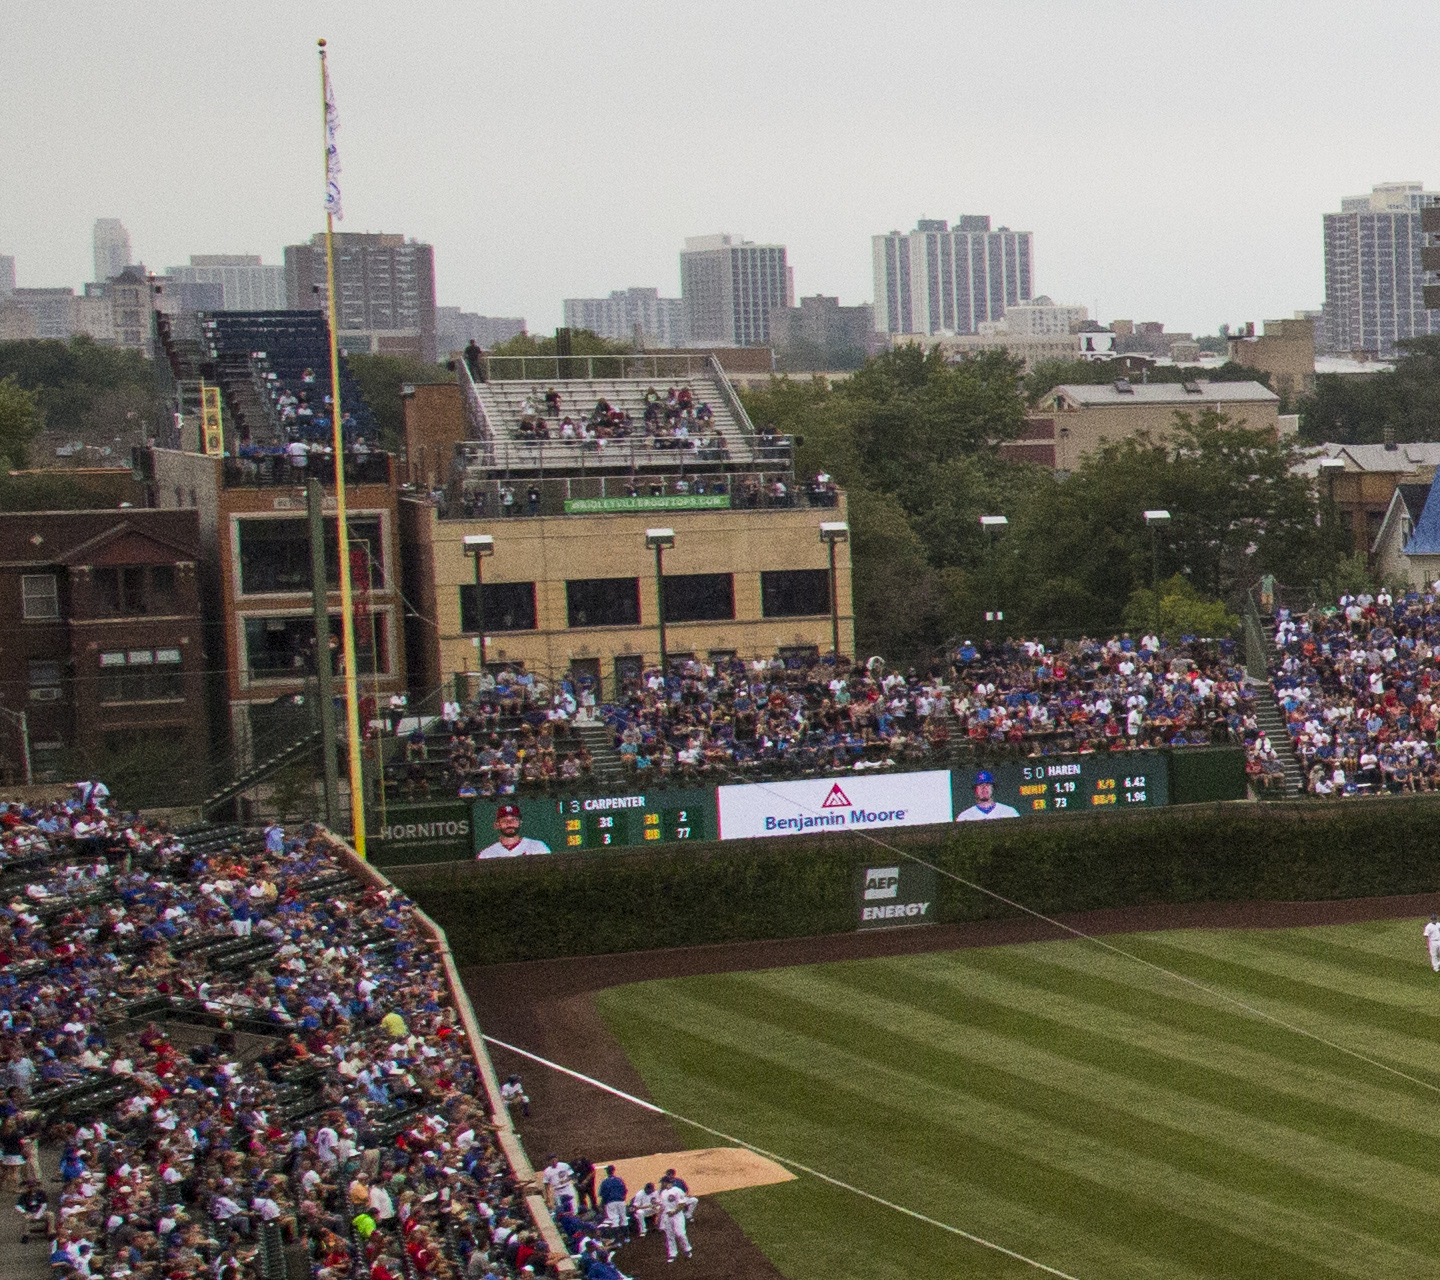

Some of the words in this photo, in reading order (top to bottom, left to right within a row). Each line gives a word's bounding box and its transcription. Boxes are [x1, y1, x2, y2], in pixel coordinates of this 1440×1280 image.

[1048, 764, 1080, 777] HAREN
[584, 796, 645, 810] CARPENTER
[765, 811, 845, 832] Benjamin
[850, 807, 907, 823] Moore
[381, 821, 468, 838] HORNITOS
[867, 876, 898, 890] AEP
[862, 902, 930, 920] ENERGY
